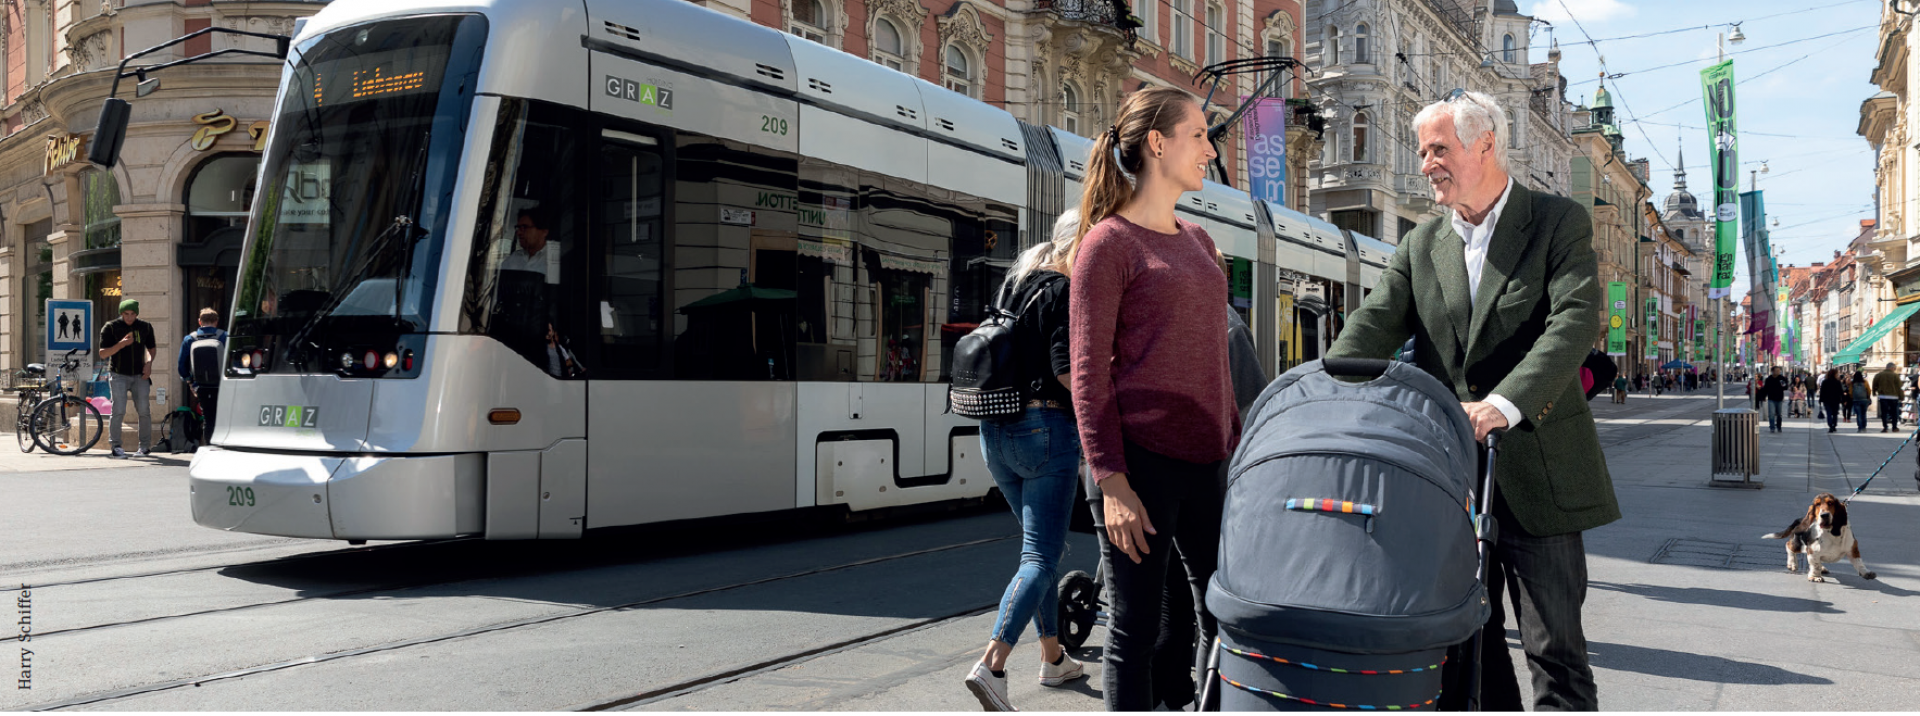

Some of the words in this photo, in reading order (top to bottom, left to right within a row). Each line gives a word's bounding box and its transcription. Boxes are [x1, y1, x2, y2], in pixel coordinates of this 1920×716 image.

[353, 66, 424, 97] Liebenau
[606, 75, 673, 109] GRAZ
[761, 115, 788, 136] 209
[1253, 133, 1284, 156] as
[1249, 156, 1281, 178] se
[259, 405, 318, 428] GRAZ
[227, 486, 256, 507] 209
